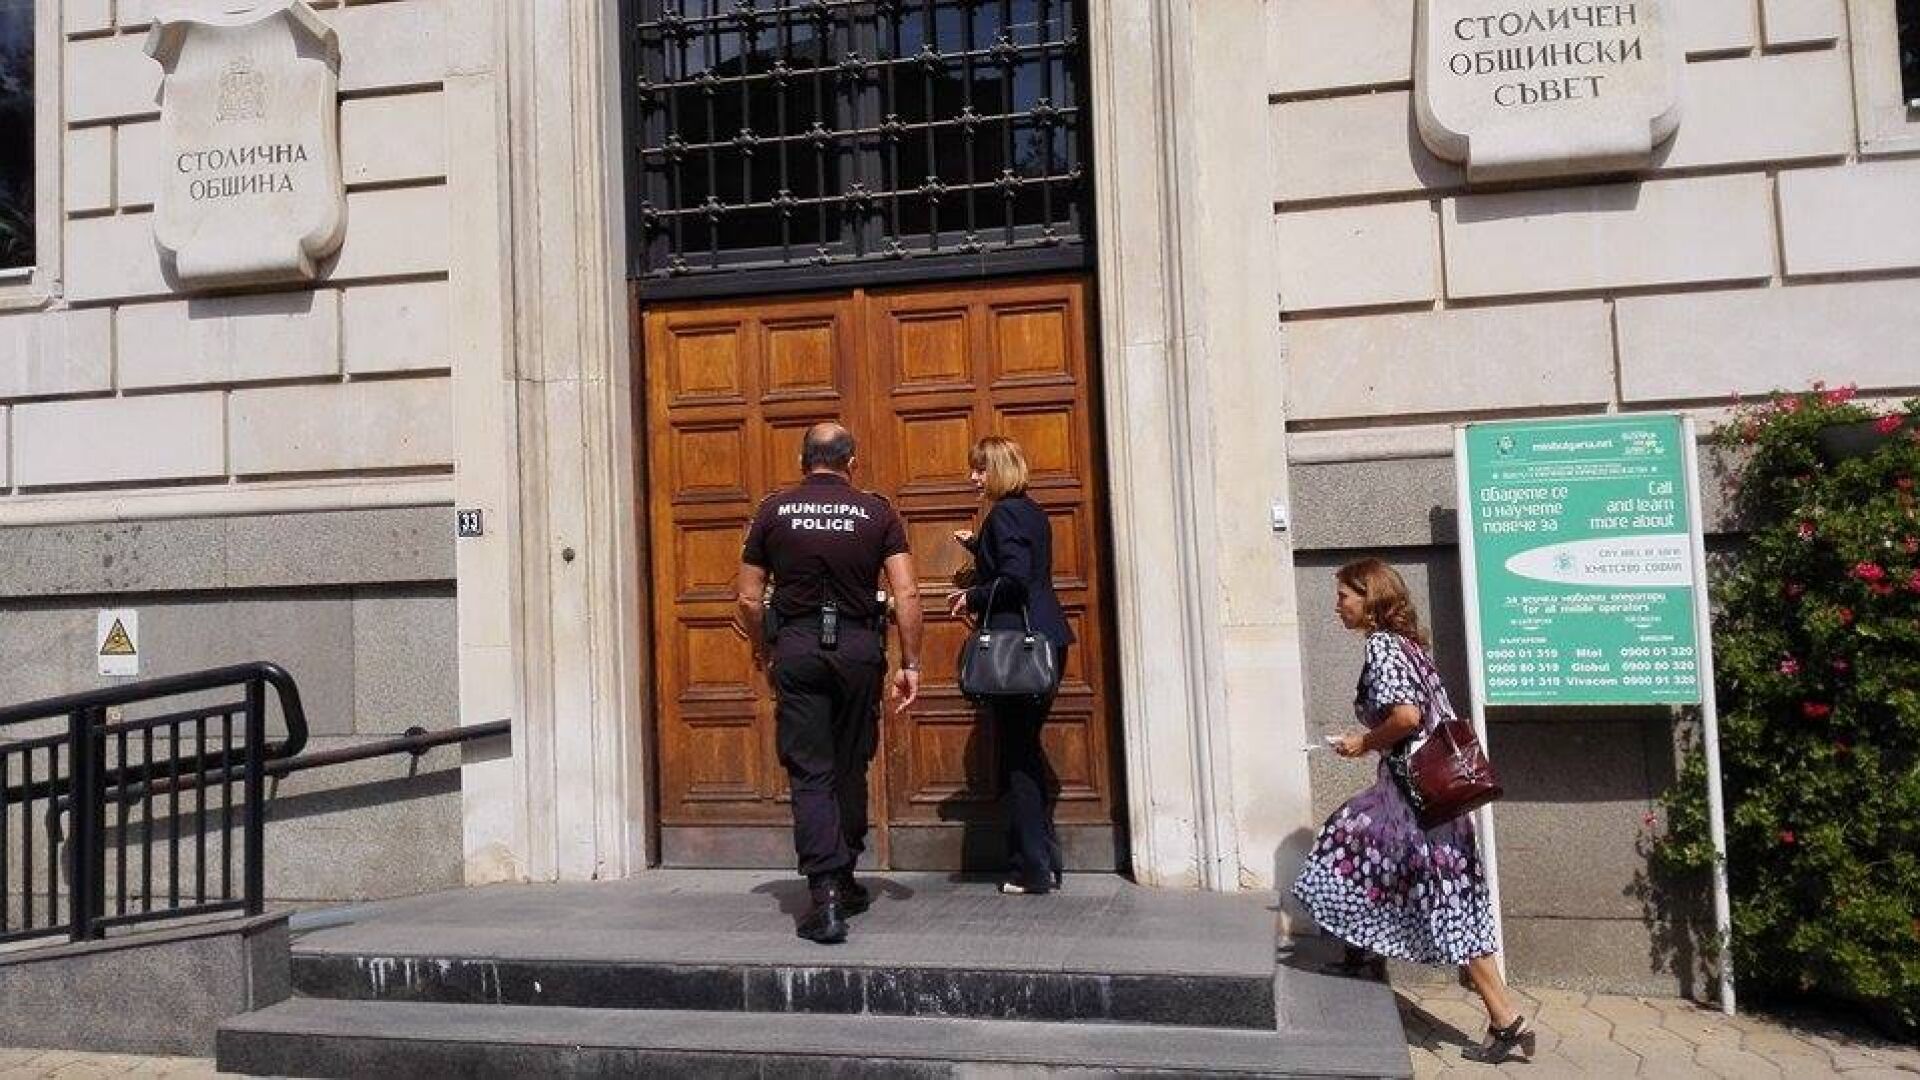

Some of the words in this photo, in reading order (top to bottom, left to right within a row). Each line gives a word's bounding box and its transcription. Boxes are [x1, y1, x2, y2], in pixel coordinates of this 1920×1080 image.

[1454, 3, 1636, 40] СТОЛИЧЕН
[1449, 36, 1642, 76] ОБЩИНСКИ
[1494, 76, 1604, 106] СЪВЕТ
[177, 144, 308, 173] СТОЛИЧНА
[189, 173, 294, 200] ОБЩИНА
[1648, 480, 1673, 495] Call
[778, 502, 870, 519] MUNICIPAL
[1606, 499, 1633, 513] and
[1636, 498, 1675, 511] learn
[462, 512, 478, 532] 33
[791, 518, 855, 531] POLICE
[1590, 516, 1628, 529] more
[1632, 514, 1675, 528] about
[1566, 676, 1618, 686] Vivacom
